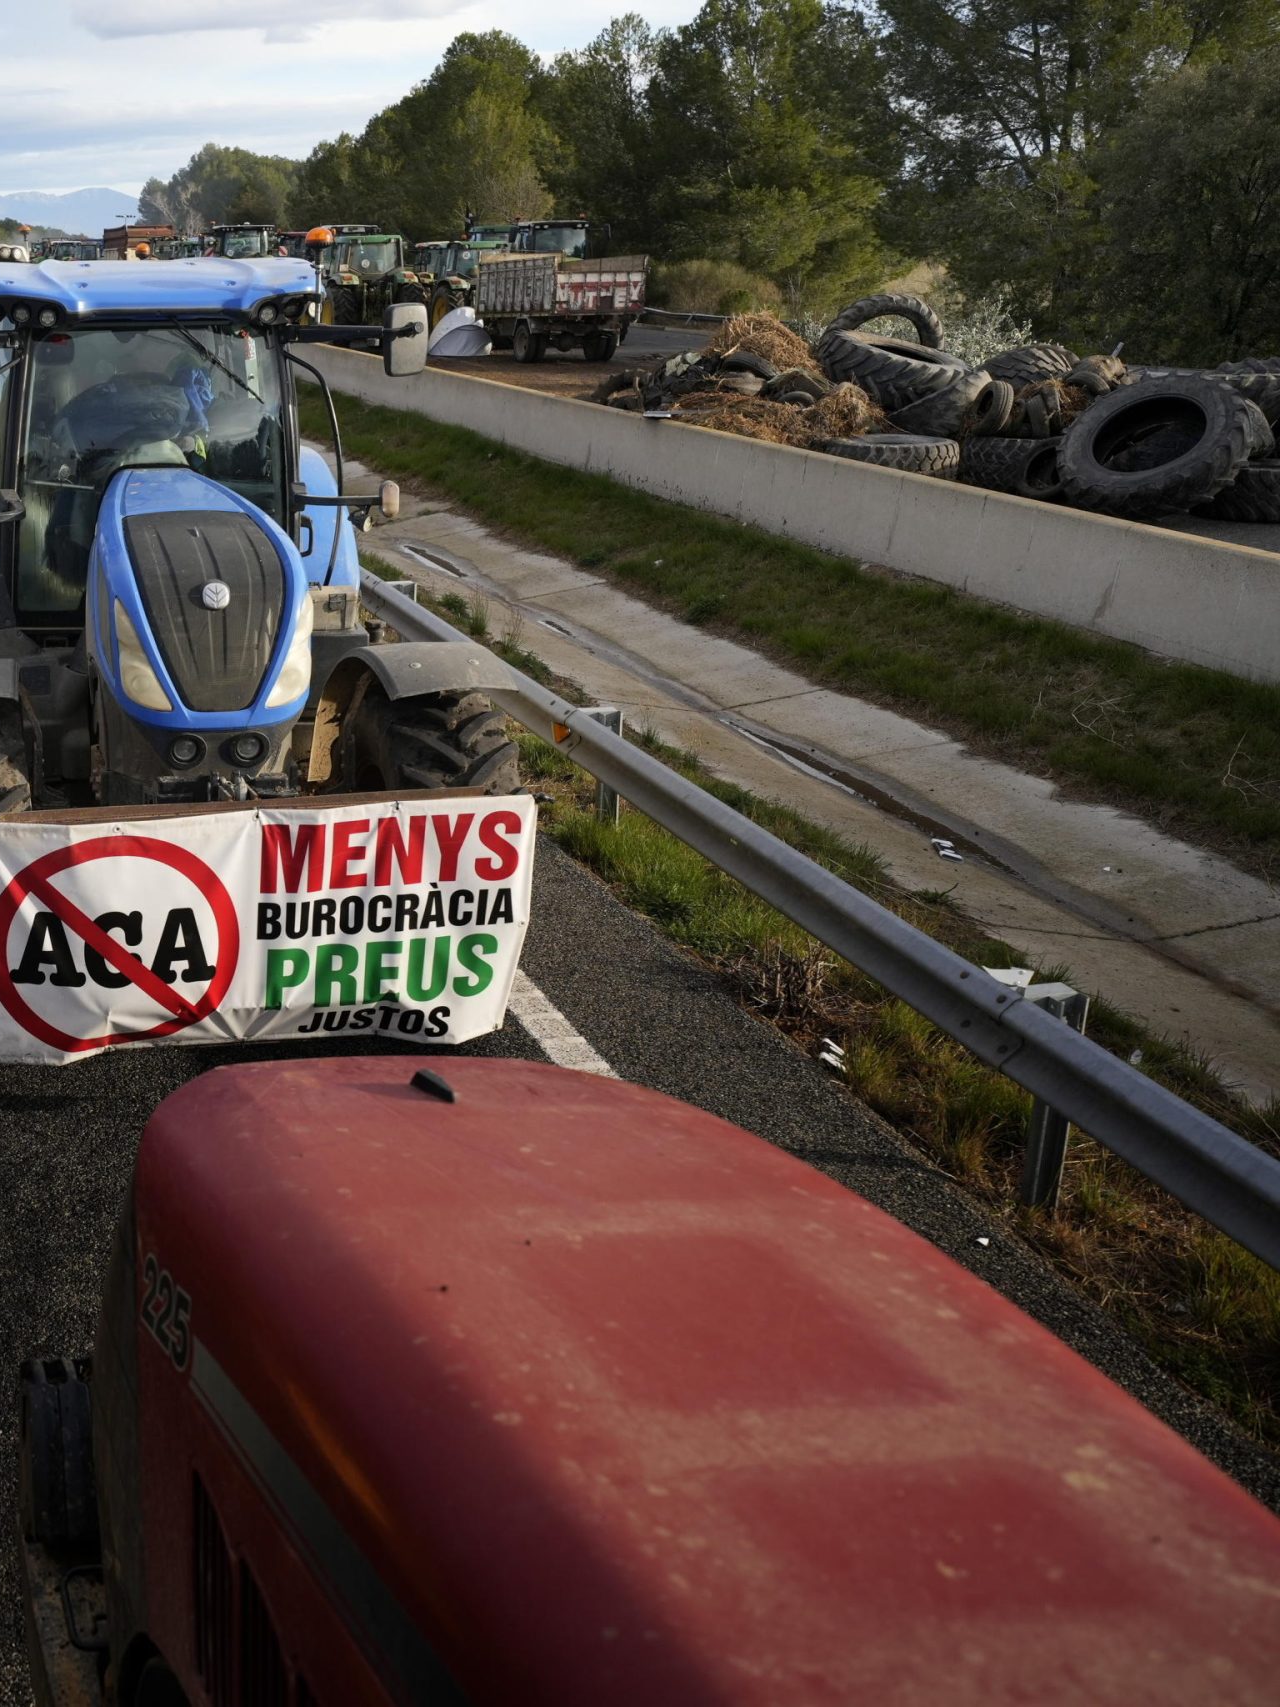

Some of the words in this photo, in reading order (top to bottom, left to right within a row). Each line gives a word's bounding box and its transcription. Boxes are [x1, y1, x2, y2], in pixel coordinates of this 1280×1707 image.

[260, 810, 522, 894] MENYS
[10, 907, 216, 988] ACA
[257, 883, 513, 939] BUROCRÀCIA
[264, 933, 498, 1010] PREUS
[298, 1005, 451, 1037] JUSTOS
[141, 1253, 192, 1371] 225
